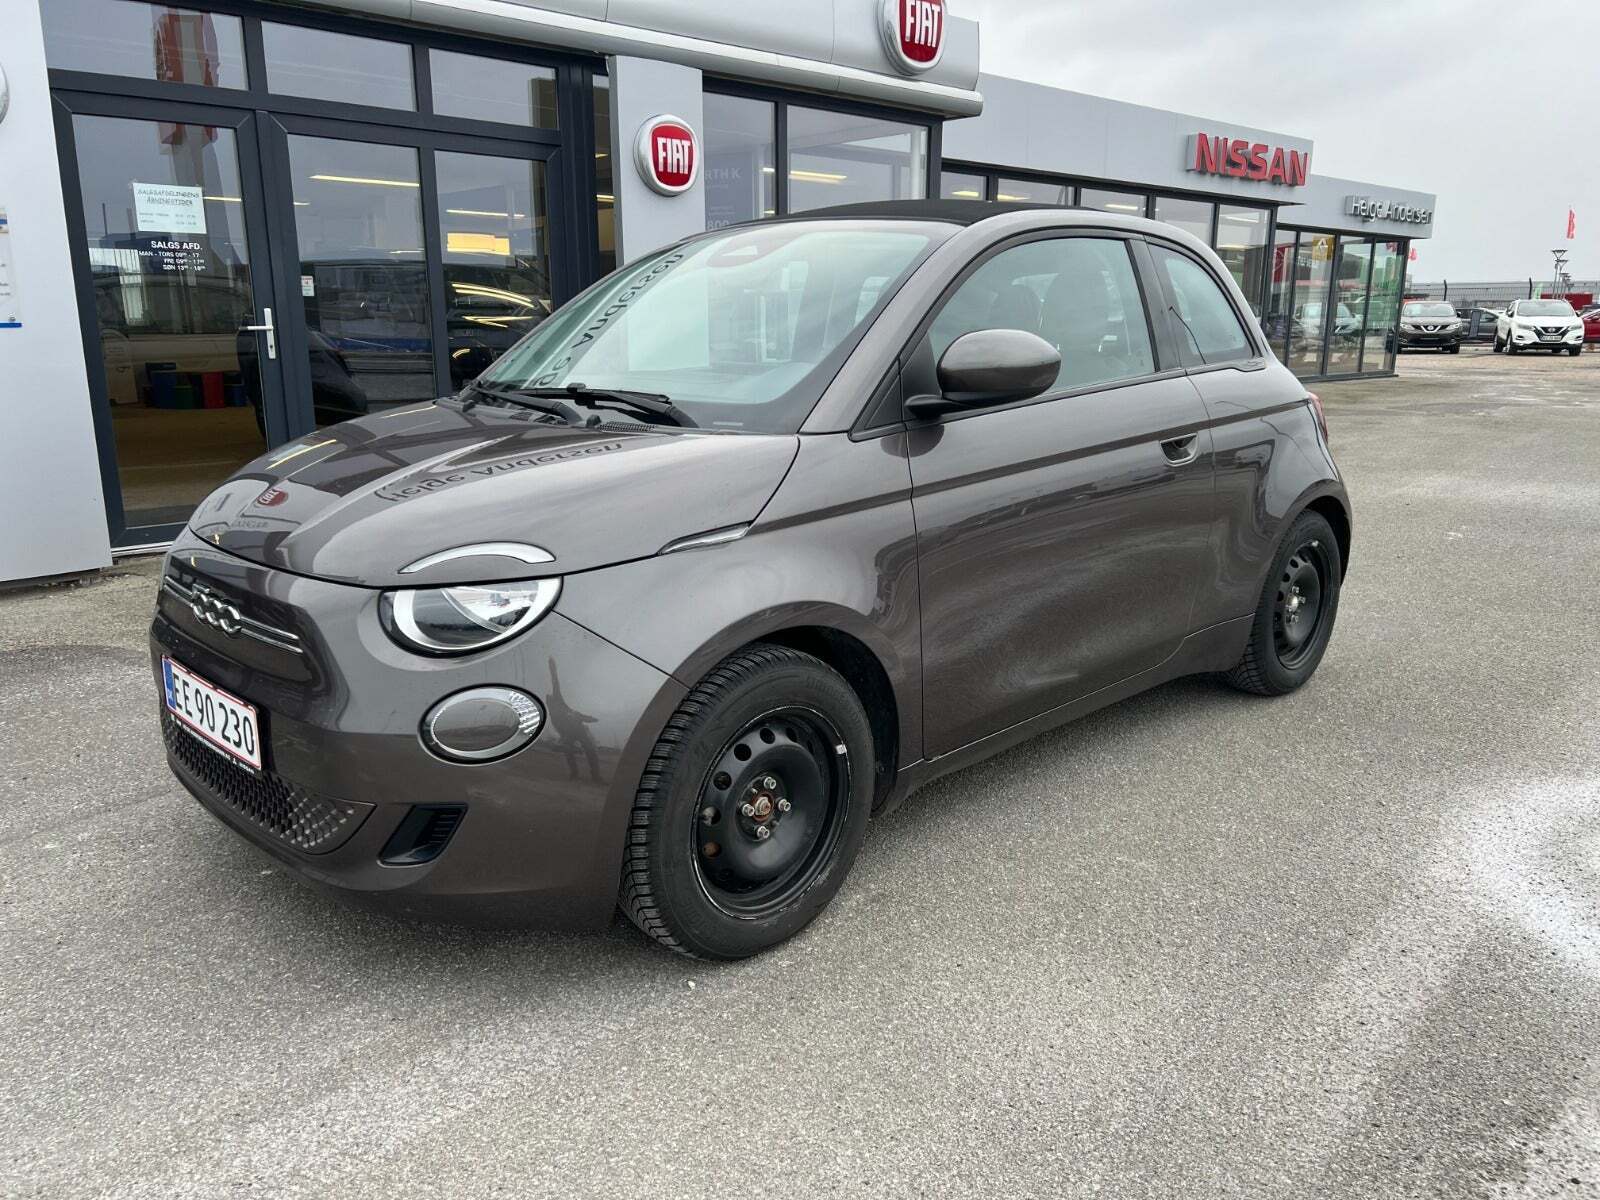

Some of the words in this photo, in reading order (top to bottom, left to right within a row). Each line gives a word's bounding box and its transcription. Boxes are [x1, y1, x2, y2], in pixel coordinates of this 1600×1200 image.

[905, 0, 941, 48] FIAT
[657, 137, 691, 175] FIAT
[1195, 132, 1308, 186] NISSAN
[151, 240, 180, 249] SALGS
[182, 241, 203, 250] AFD.
[195, 688, 215, 732] 90
[219, 702, 255, 756] 230
